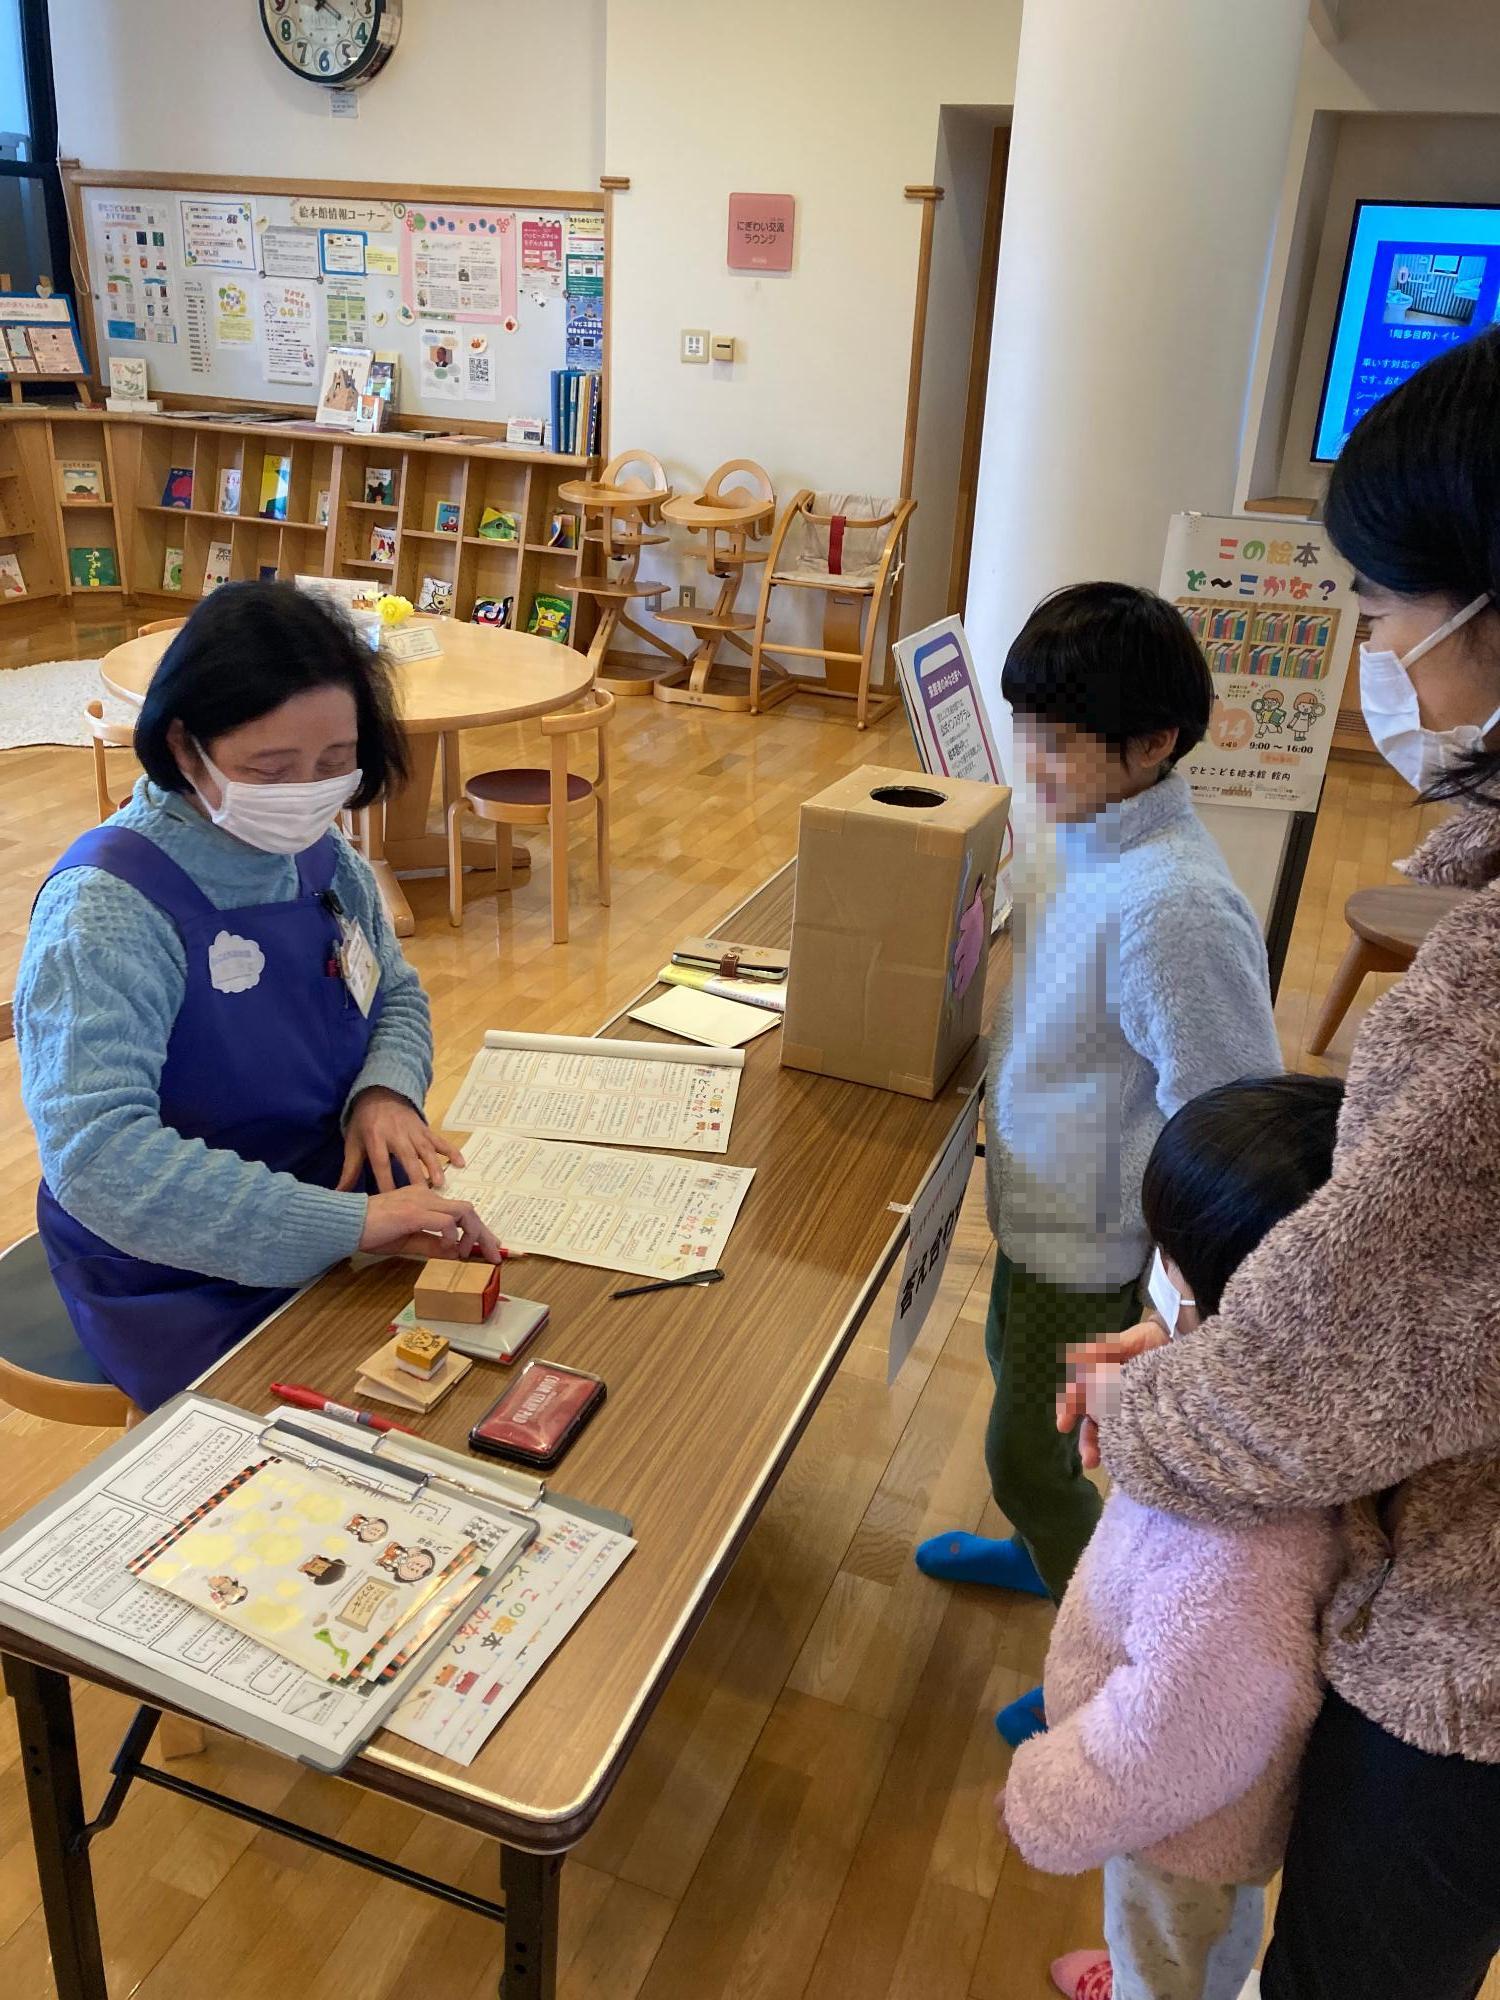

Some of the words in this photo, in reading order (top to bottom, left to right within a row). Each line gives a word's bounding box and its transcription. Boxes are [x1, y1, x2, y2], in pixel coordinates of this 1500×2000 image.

[281, 19, 291, 41] 8
[355, 22, 368, 44] 4
[297, 42, 307, 63] 7
[319, 50, 330, 72] 6
[299, 206, 386, 220] 絵本館情報コーナー
[737, 221, 784, 232] にぎわい交流
[744, 234, 776, 244] ラウンジ
[1389, 329, 1460, 341] 1階多目的トイレ
[1219, 538, 1320, 567] この絵本
[1218, 720, 1246, 738] 14
[1249, 742, 1270, 750] 9:00
[1190, 766, 1267, 779] 空とこども絵本館
[1271, 771, 1291, 781] 館内
[481, 1588, 541, 1650] この絵本
